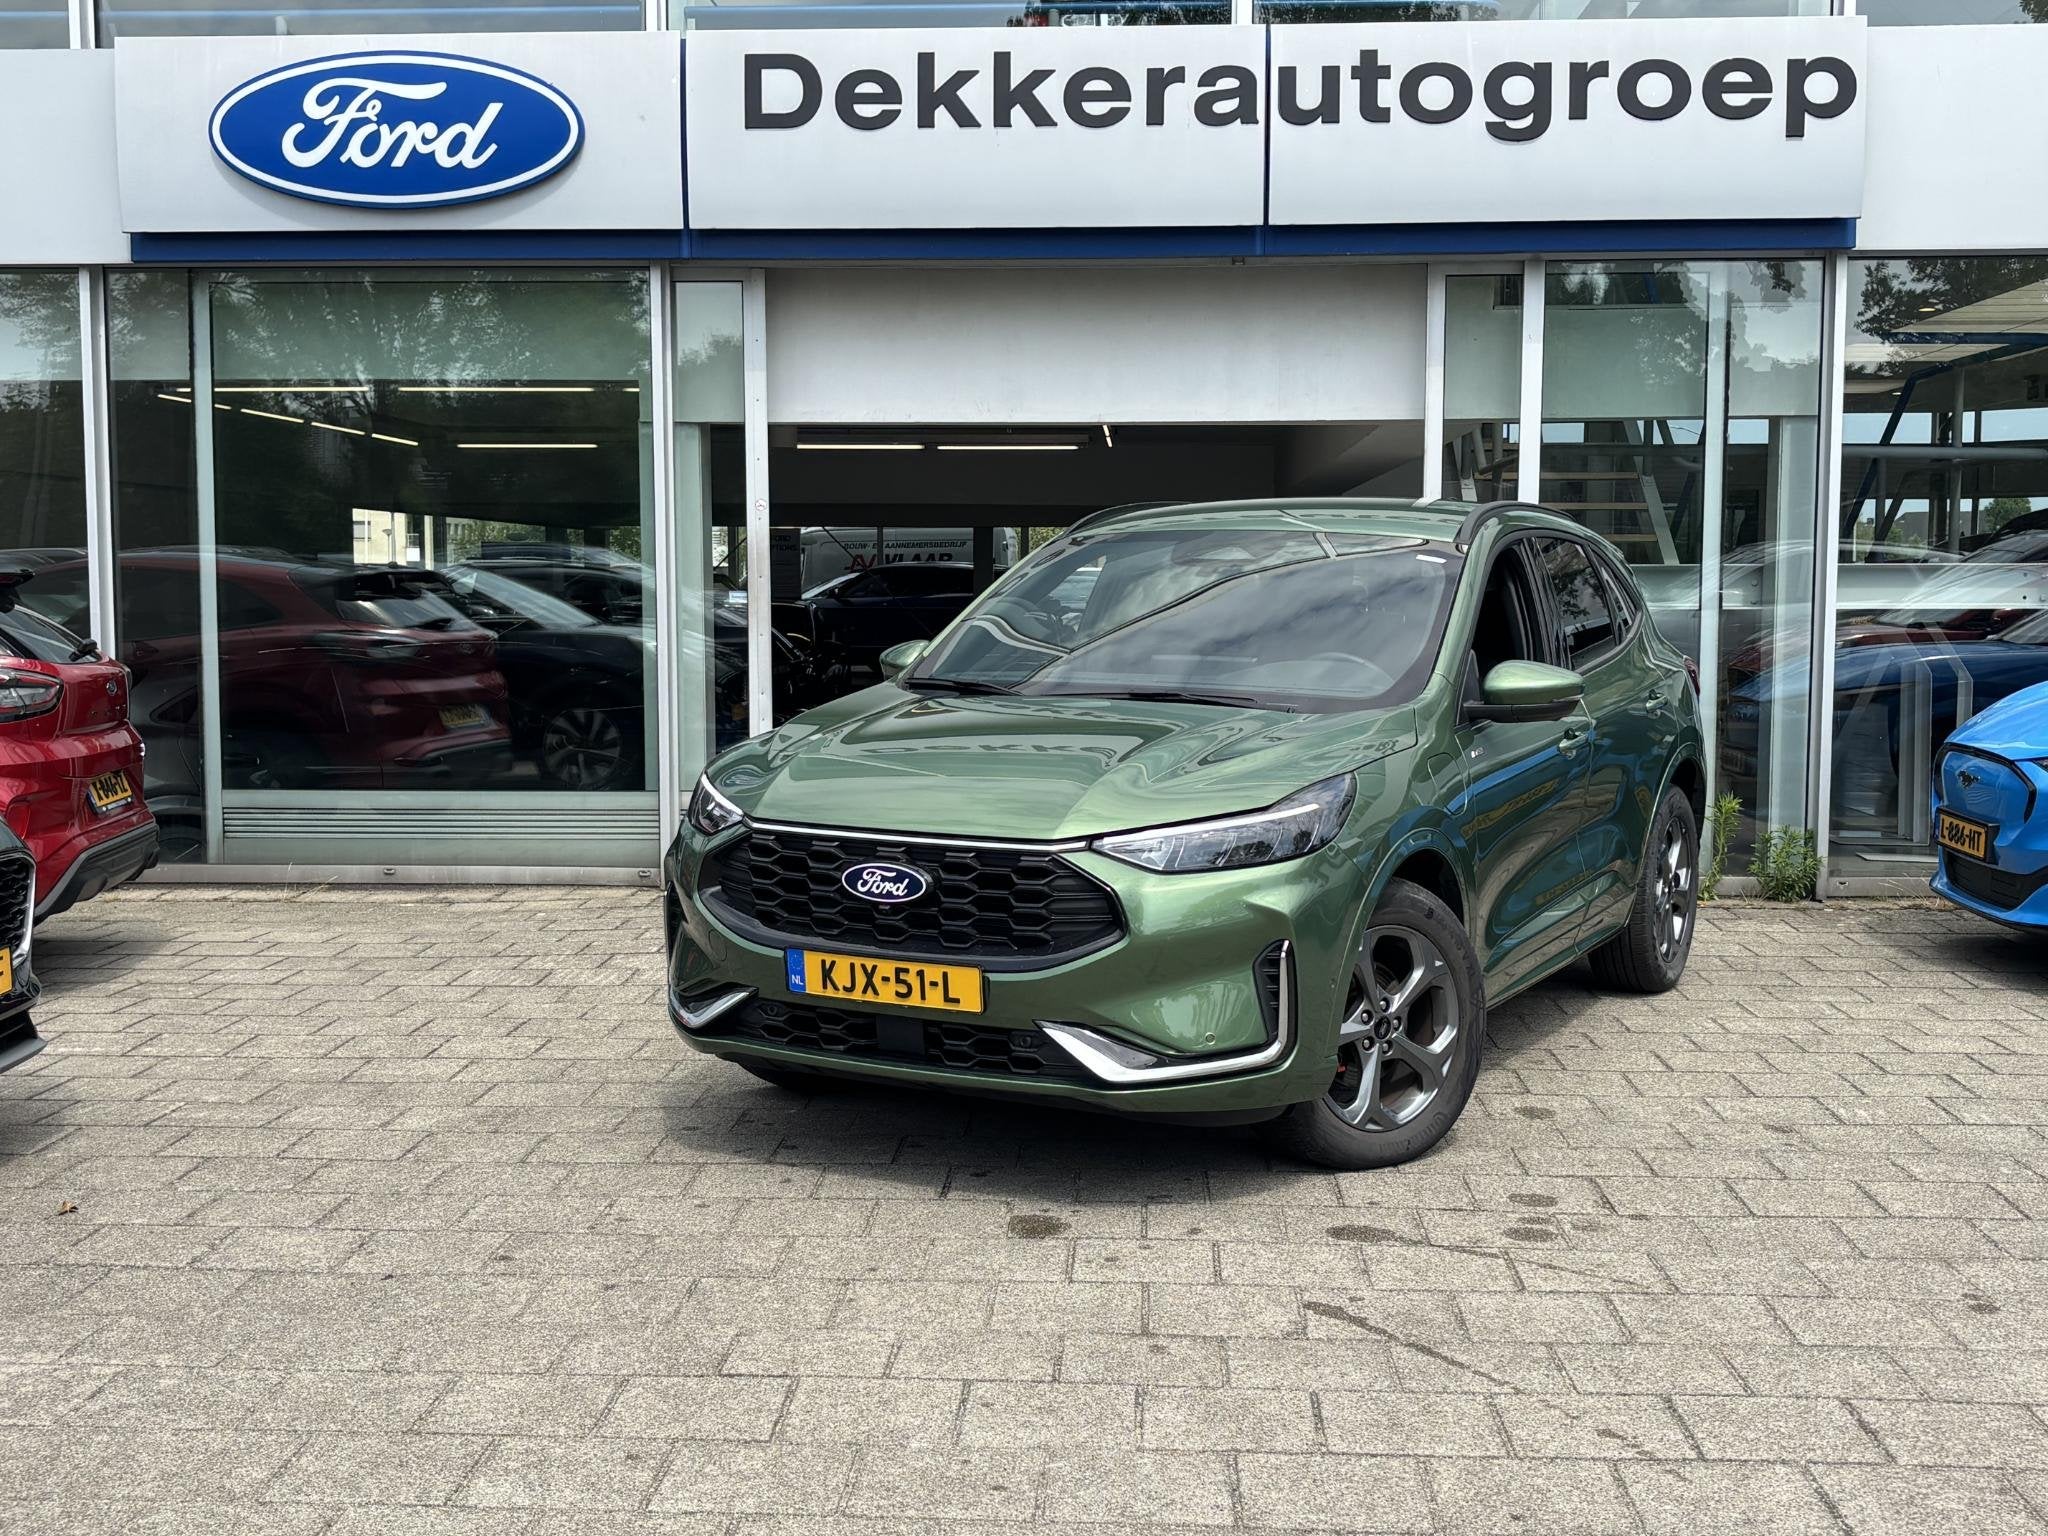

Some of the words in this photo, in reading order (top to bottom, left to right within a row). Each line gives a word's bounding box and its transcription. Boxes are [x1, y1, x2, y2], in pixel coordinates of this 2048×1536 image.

[281, 77, 504, 169] Ford
[744, 48, 1858, 142] Dekkerautogroep
[857, 868, 910, 896] Ford
[791, 975, 804, 986] NL
[820, 958, 961, 1004] KJX-51-L
